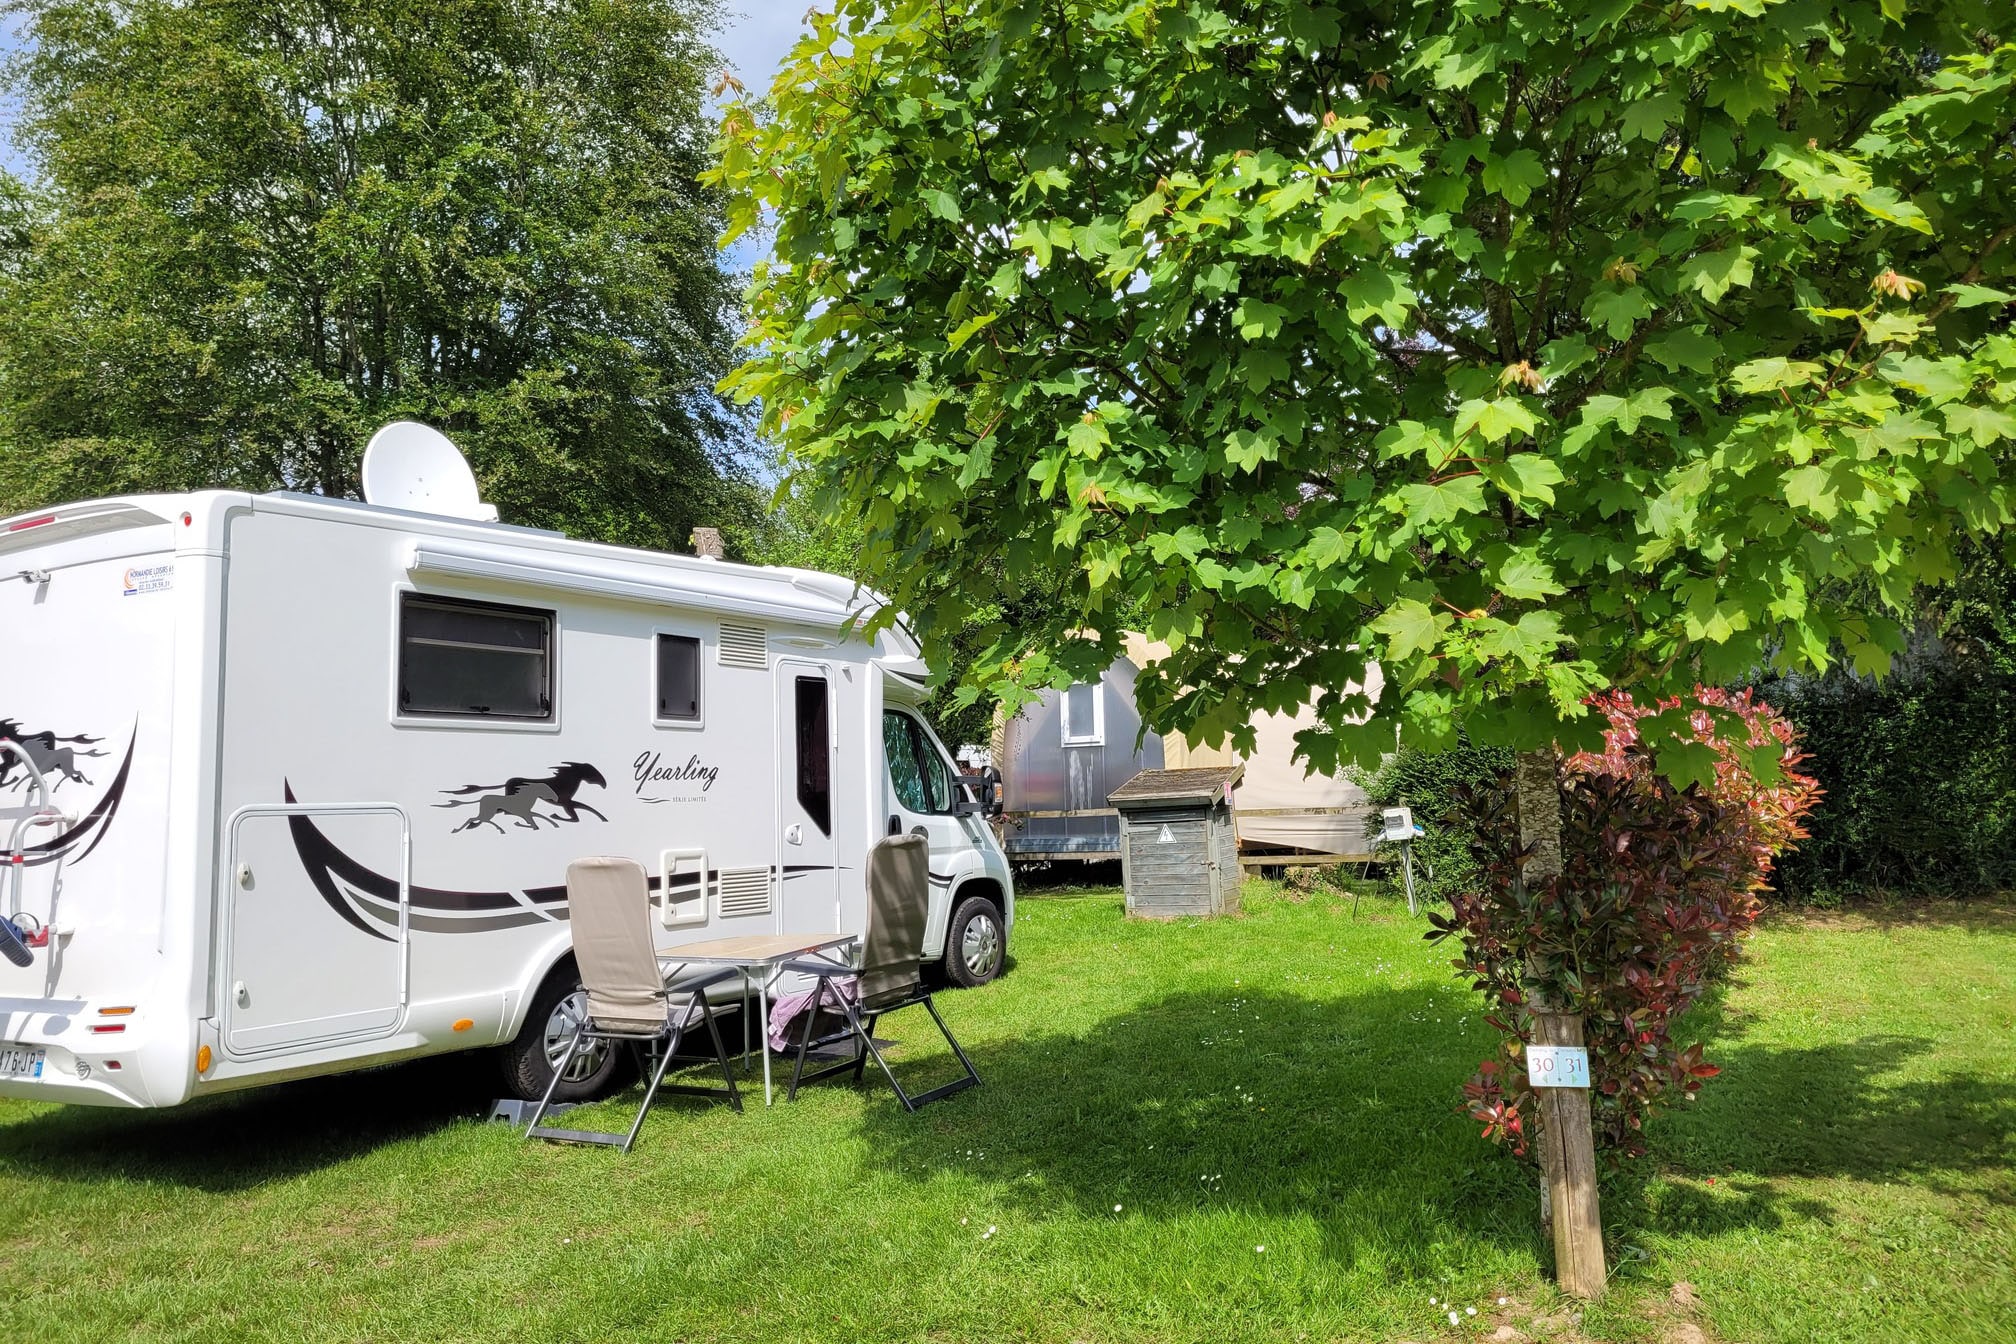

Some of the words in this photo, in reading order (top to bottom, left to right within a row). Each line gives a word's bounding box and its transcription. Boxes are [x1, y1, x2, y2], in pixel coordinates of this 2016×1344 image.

[130, 568, 153, 578] NORMANDIE
[153, 565, 169, 575] LOISIRS
[633, 750, 719, 794] Yearling
[1532, 1057, 1554, 1073] 30
[1565, 1057, 1582, 1074] 31
